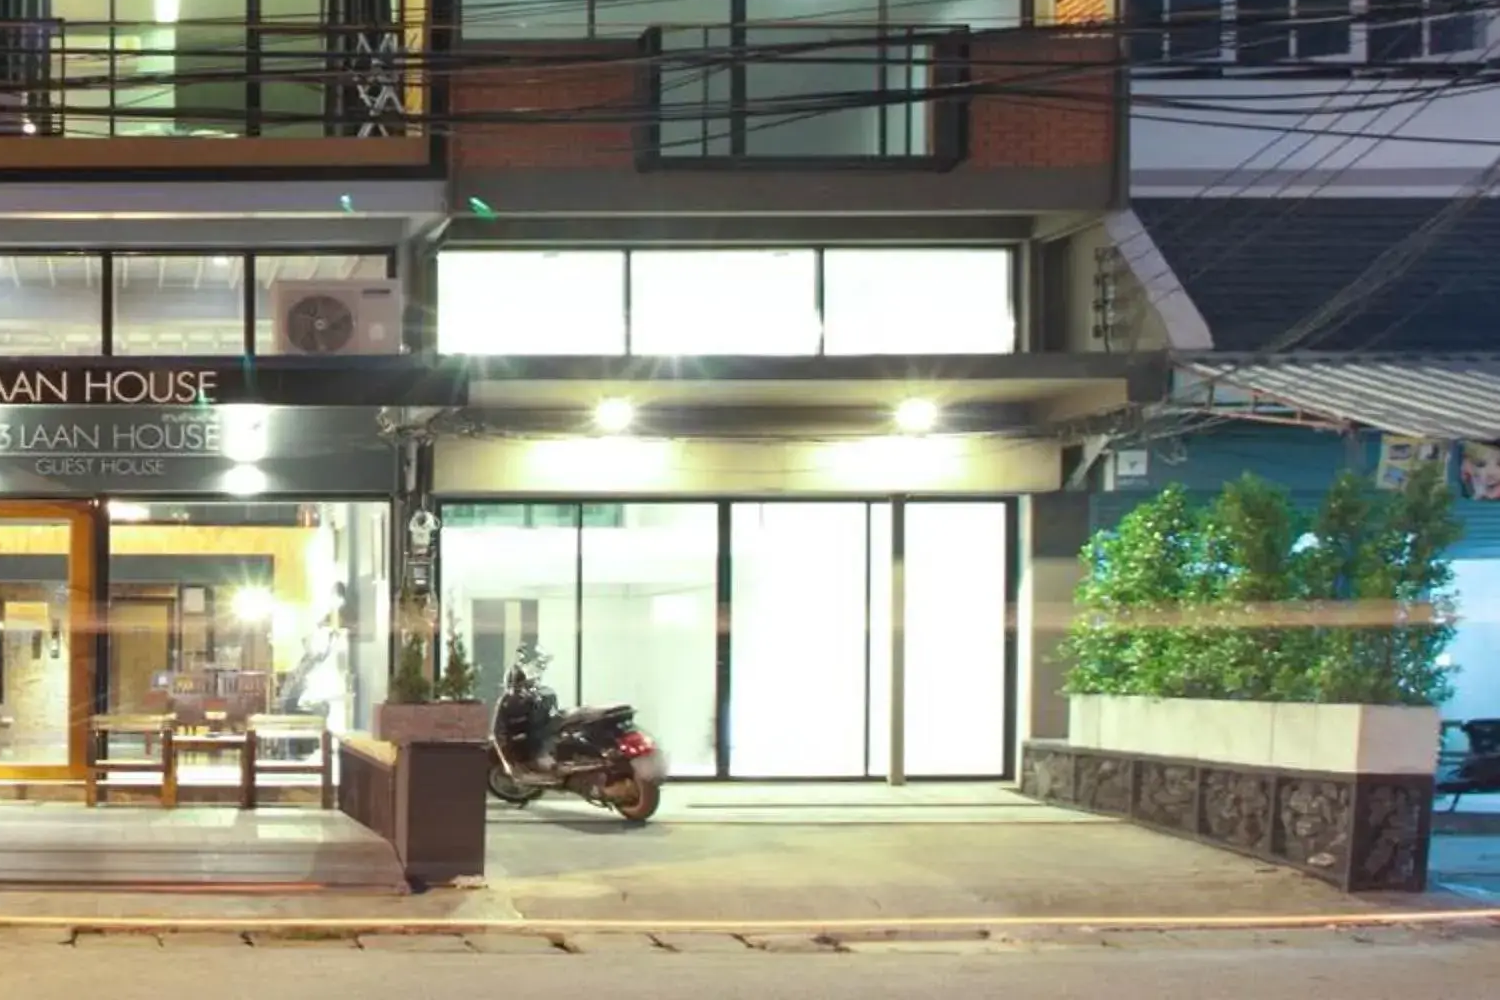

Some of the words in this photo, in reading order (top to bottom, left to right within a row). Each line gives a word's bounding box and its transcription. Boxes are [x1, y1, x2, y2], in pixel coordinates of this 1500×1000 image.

[85, 371, 218, 402] HOUSE
[19, 423, 100, 450] LAAN
[113, 423, 221, 451] HOUSE
[35, 458, 94, 476] GUEST
[100, 458, 165, 476] HOUSE
